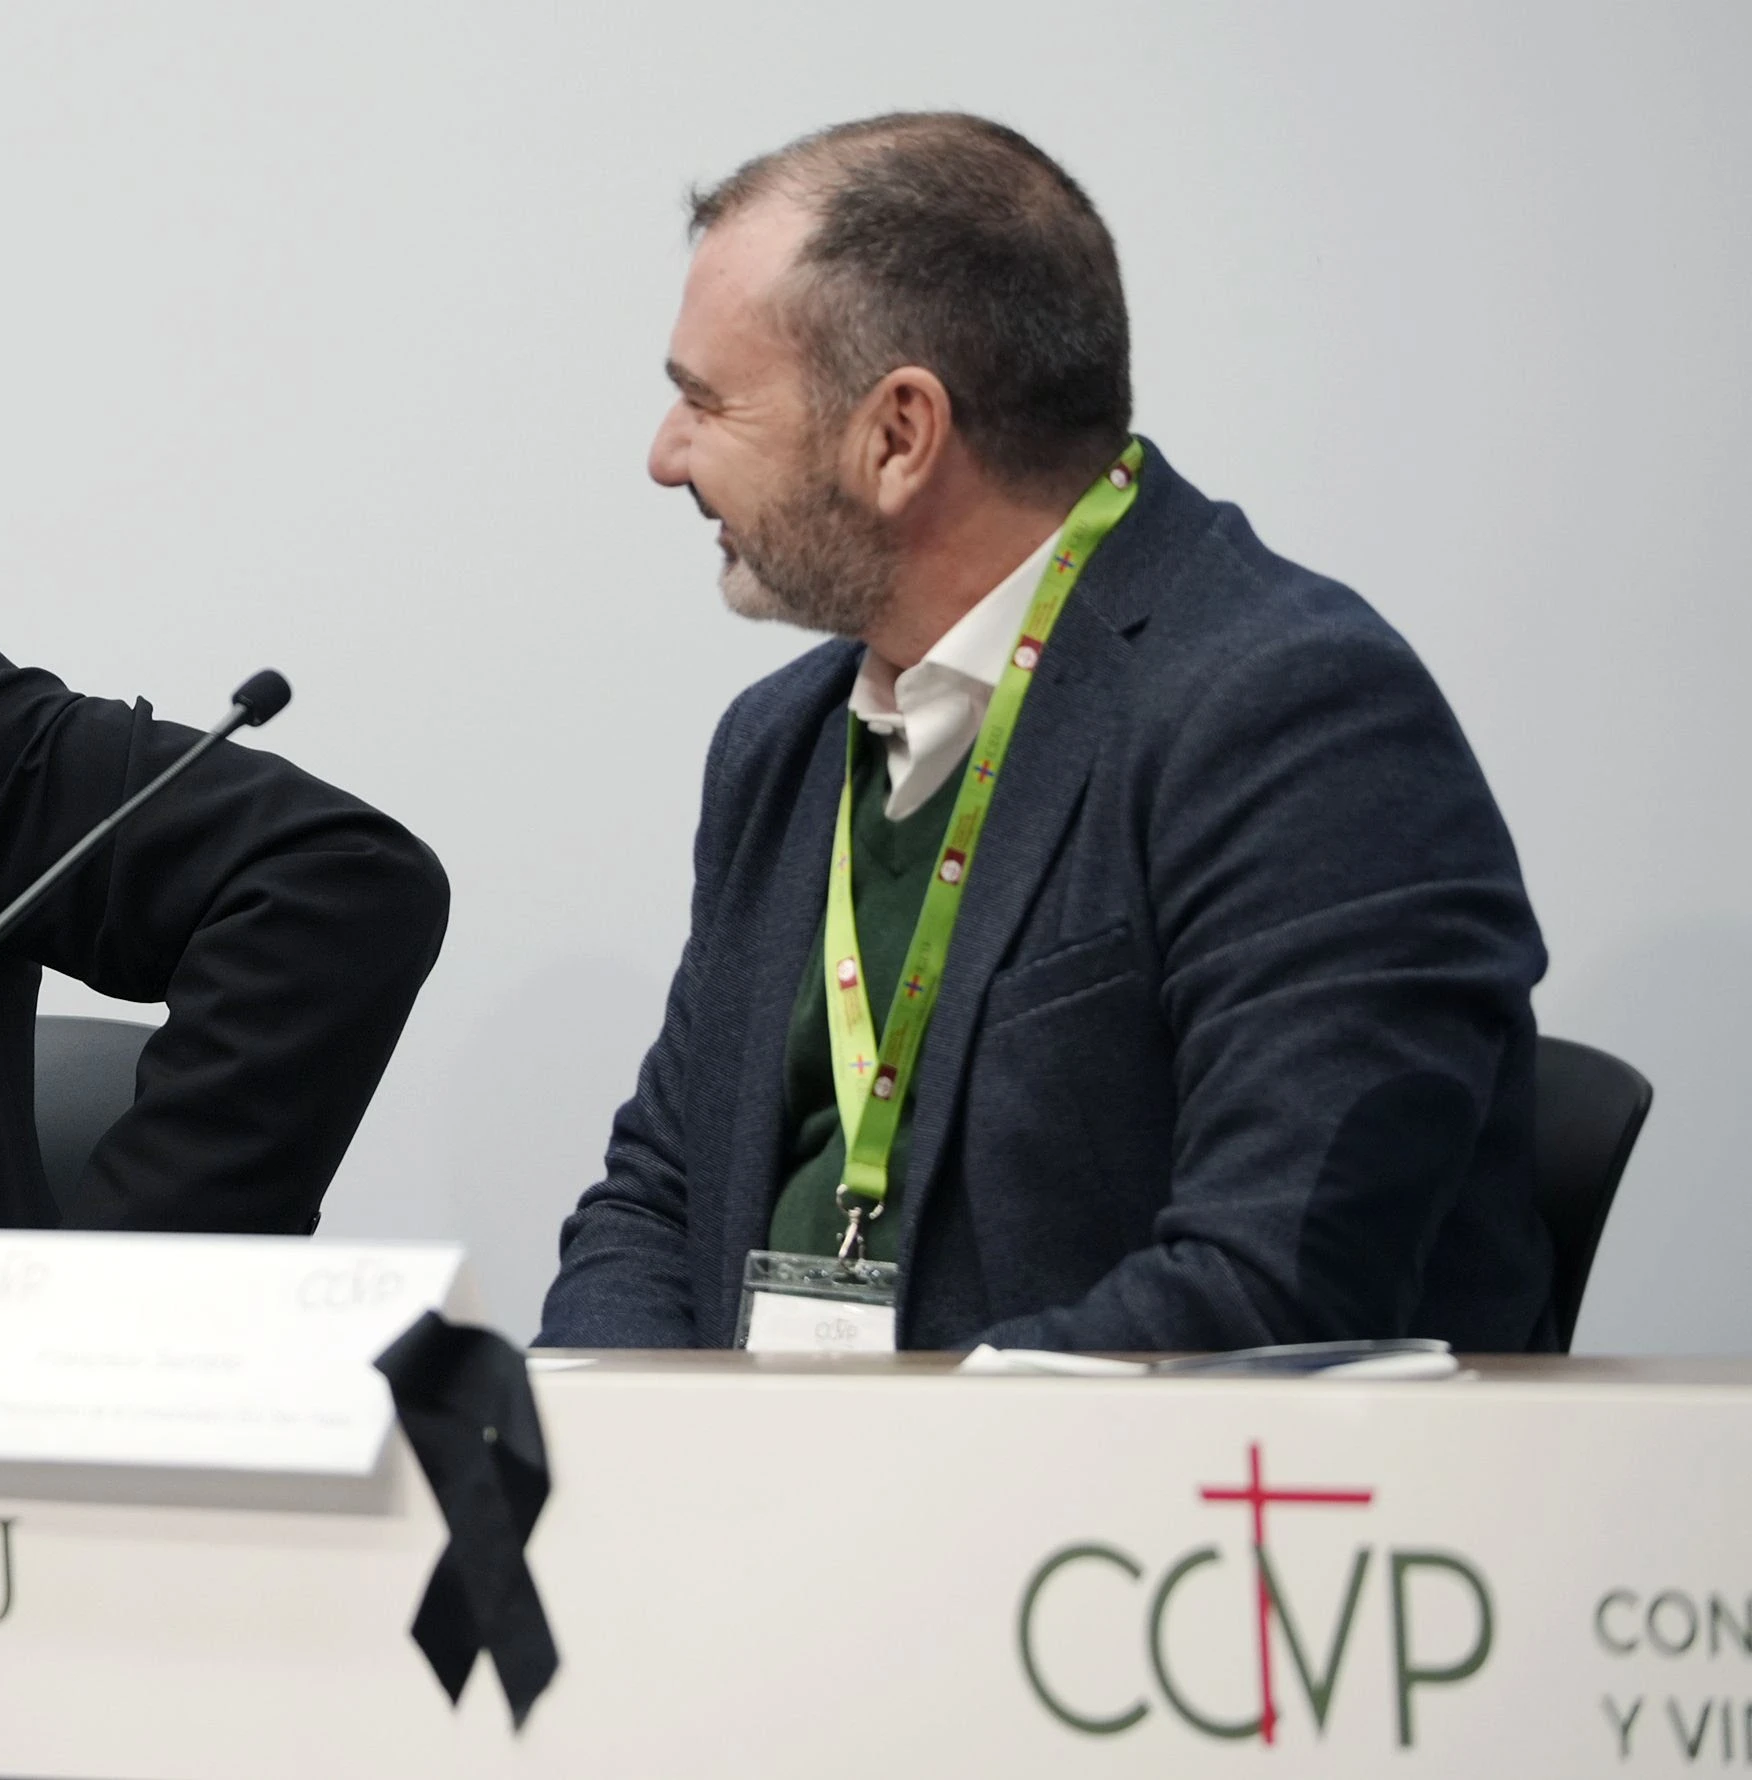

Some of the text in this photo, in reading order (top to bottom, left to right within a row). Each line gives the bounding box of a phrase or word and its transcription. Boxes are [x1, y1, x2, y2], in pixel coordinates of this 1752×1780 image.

[1017, 1539, 1497, 1749] CCVP
[1601, 1694, 1752, 1765] Y VI
